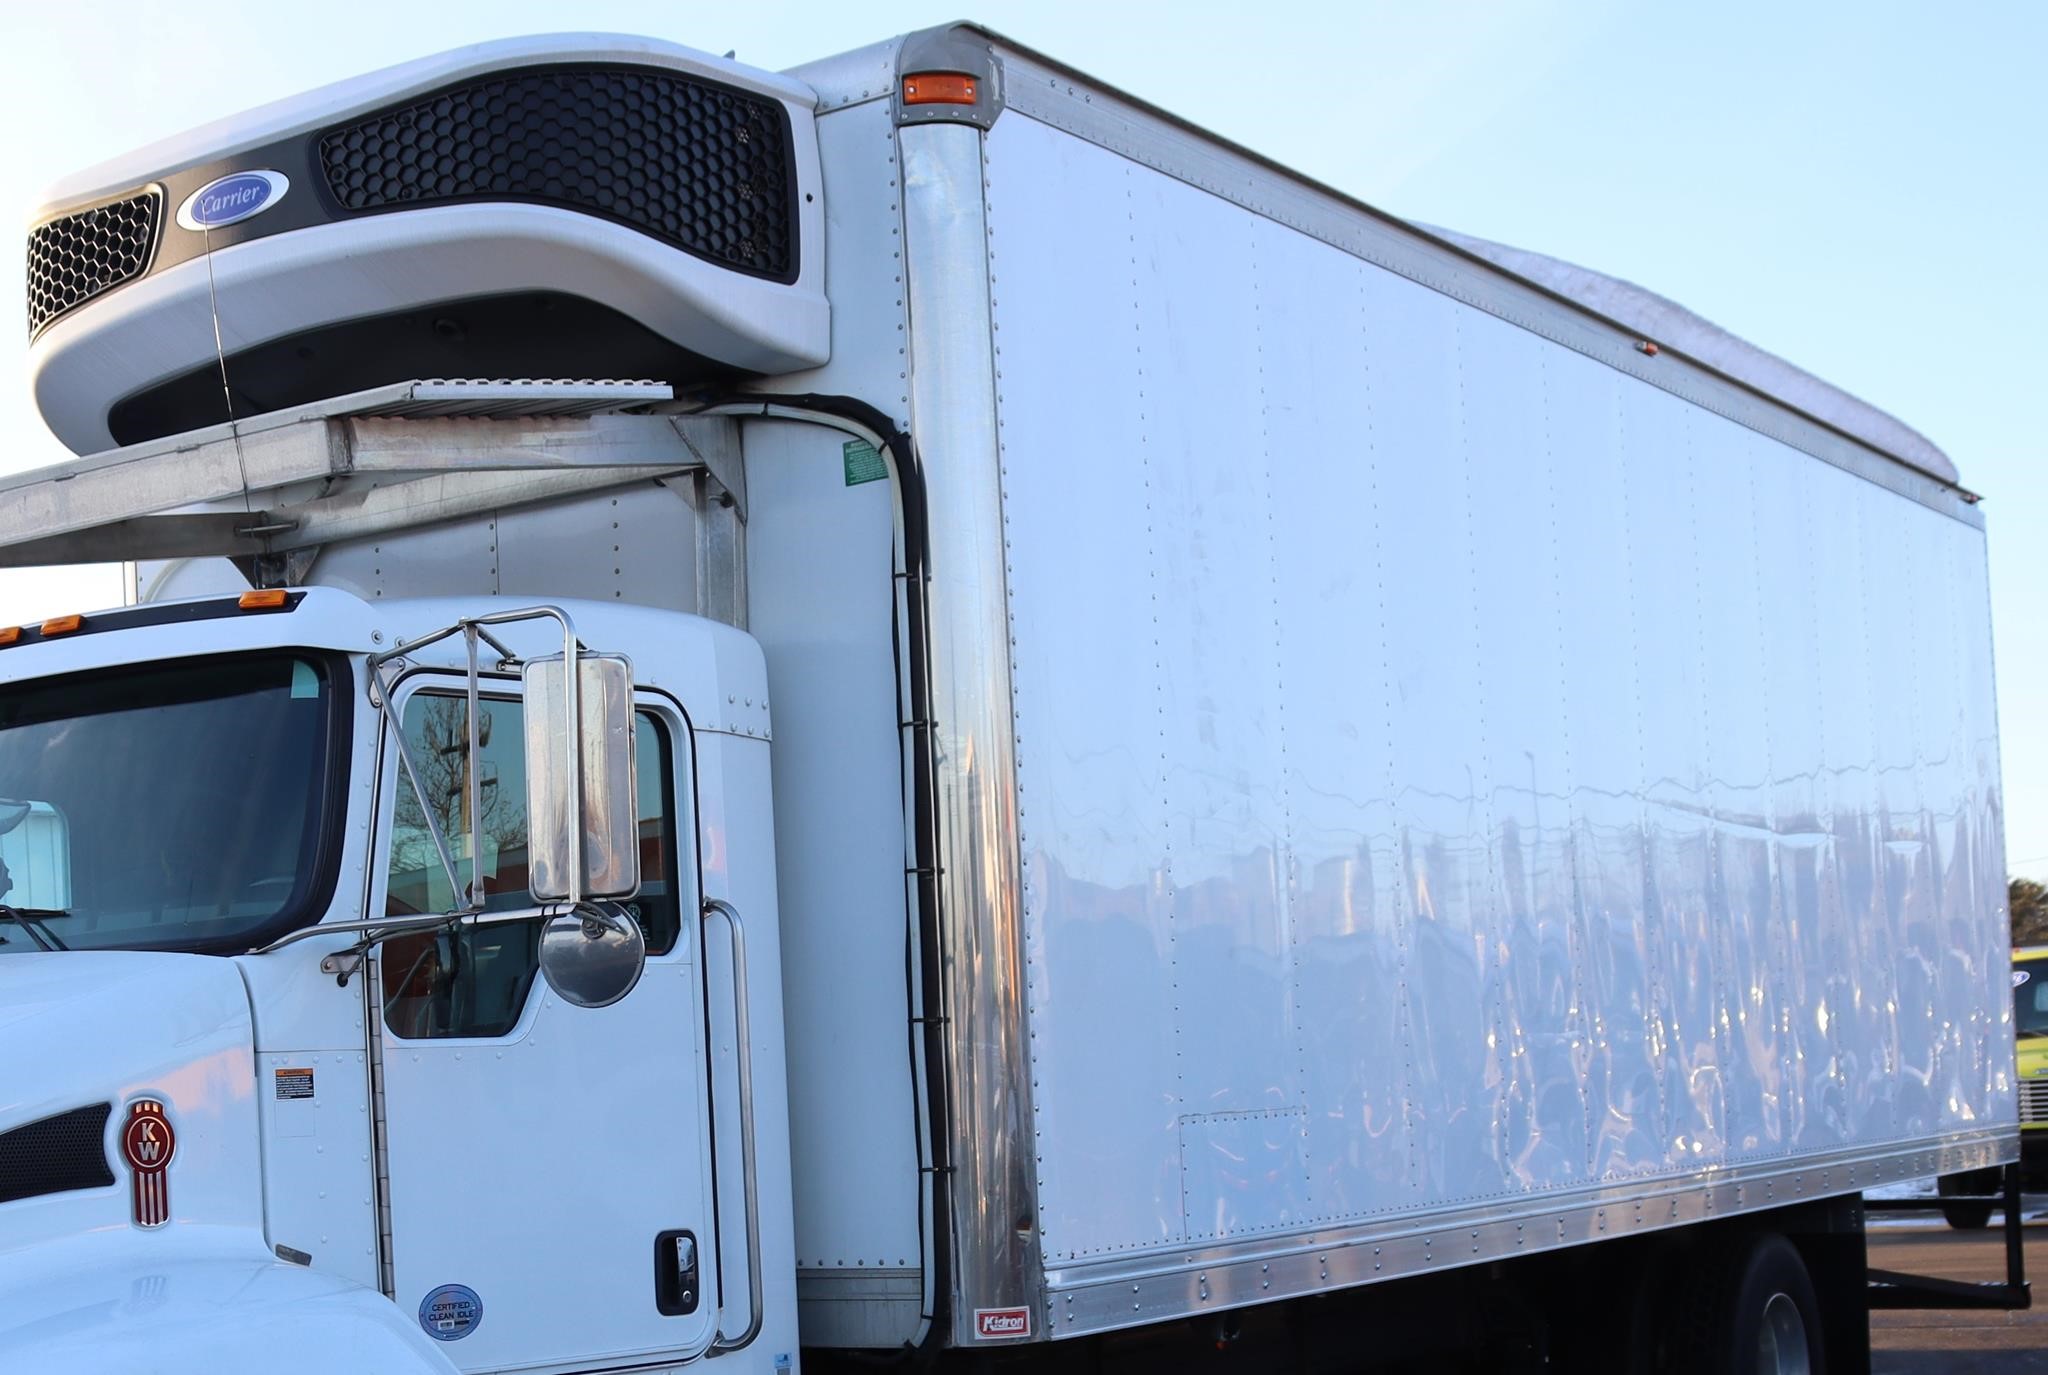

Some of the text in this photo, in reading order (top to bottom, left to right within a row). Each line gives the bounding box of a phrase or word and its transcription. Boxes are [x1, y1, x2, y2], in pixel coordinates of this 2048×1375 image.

[203, 185, 260, 215] Carrier
[141, 1122, 156, 1141] K
[138, 1141, 160, 1160] W
[432, 1301, 470, 1312] CERTIFIED
[428, 1311, 474, 1322] CLEAN IDLE
[983, 1316, 1024, 1332] Kidron
